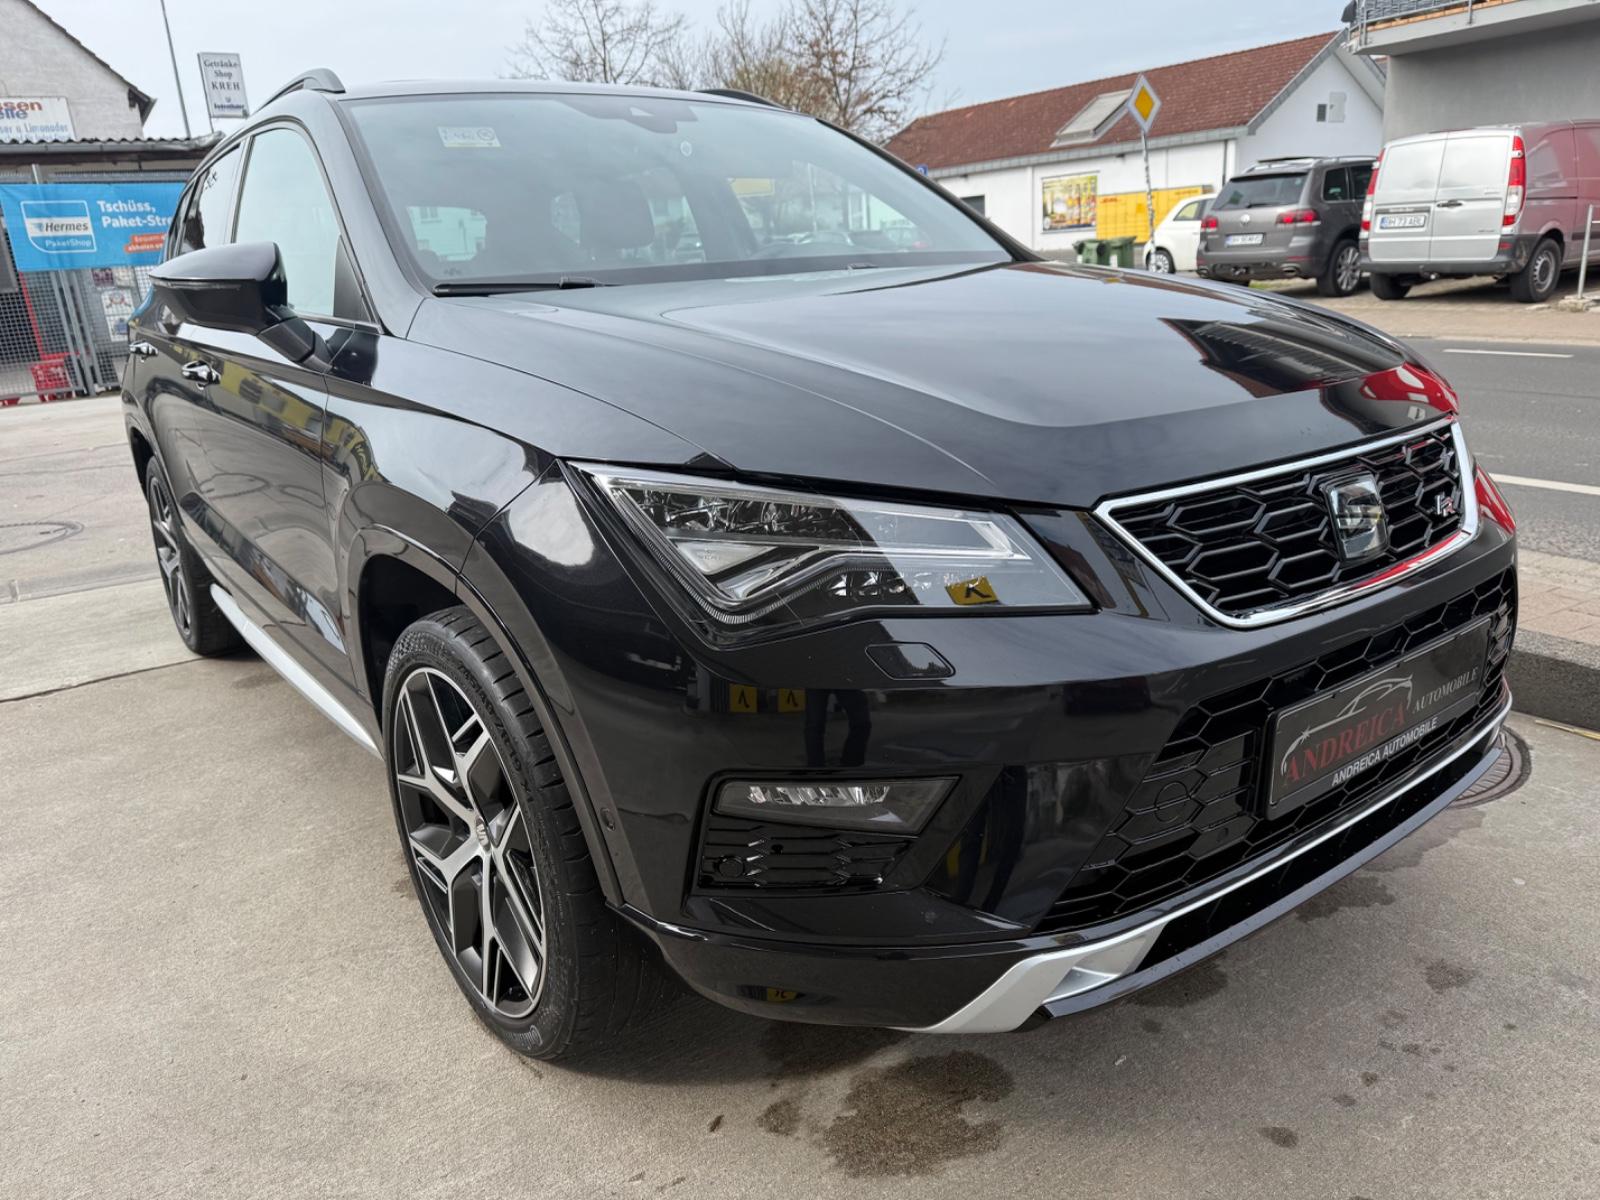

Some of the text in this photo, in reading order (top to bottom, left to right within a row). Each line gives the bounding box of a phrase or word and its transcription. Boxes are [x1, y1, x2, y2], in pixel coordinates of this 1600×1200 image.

[214, 70, 233, 80] Shop
[211, 81, 240, 90] KREH
[0, 101, 42, 111] sen
[96, 200, 156, 213] Tschüss,
[45, 222, 89, 232] Hermes
[45, 239, 92, 248] PaketShop
[1287, 666, 1479, 782] ANDREICA AUTOMOBILE
[1331, 716, 1438, 787] ANDREICA AUTOMOBILE
